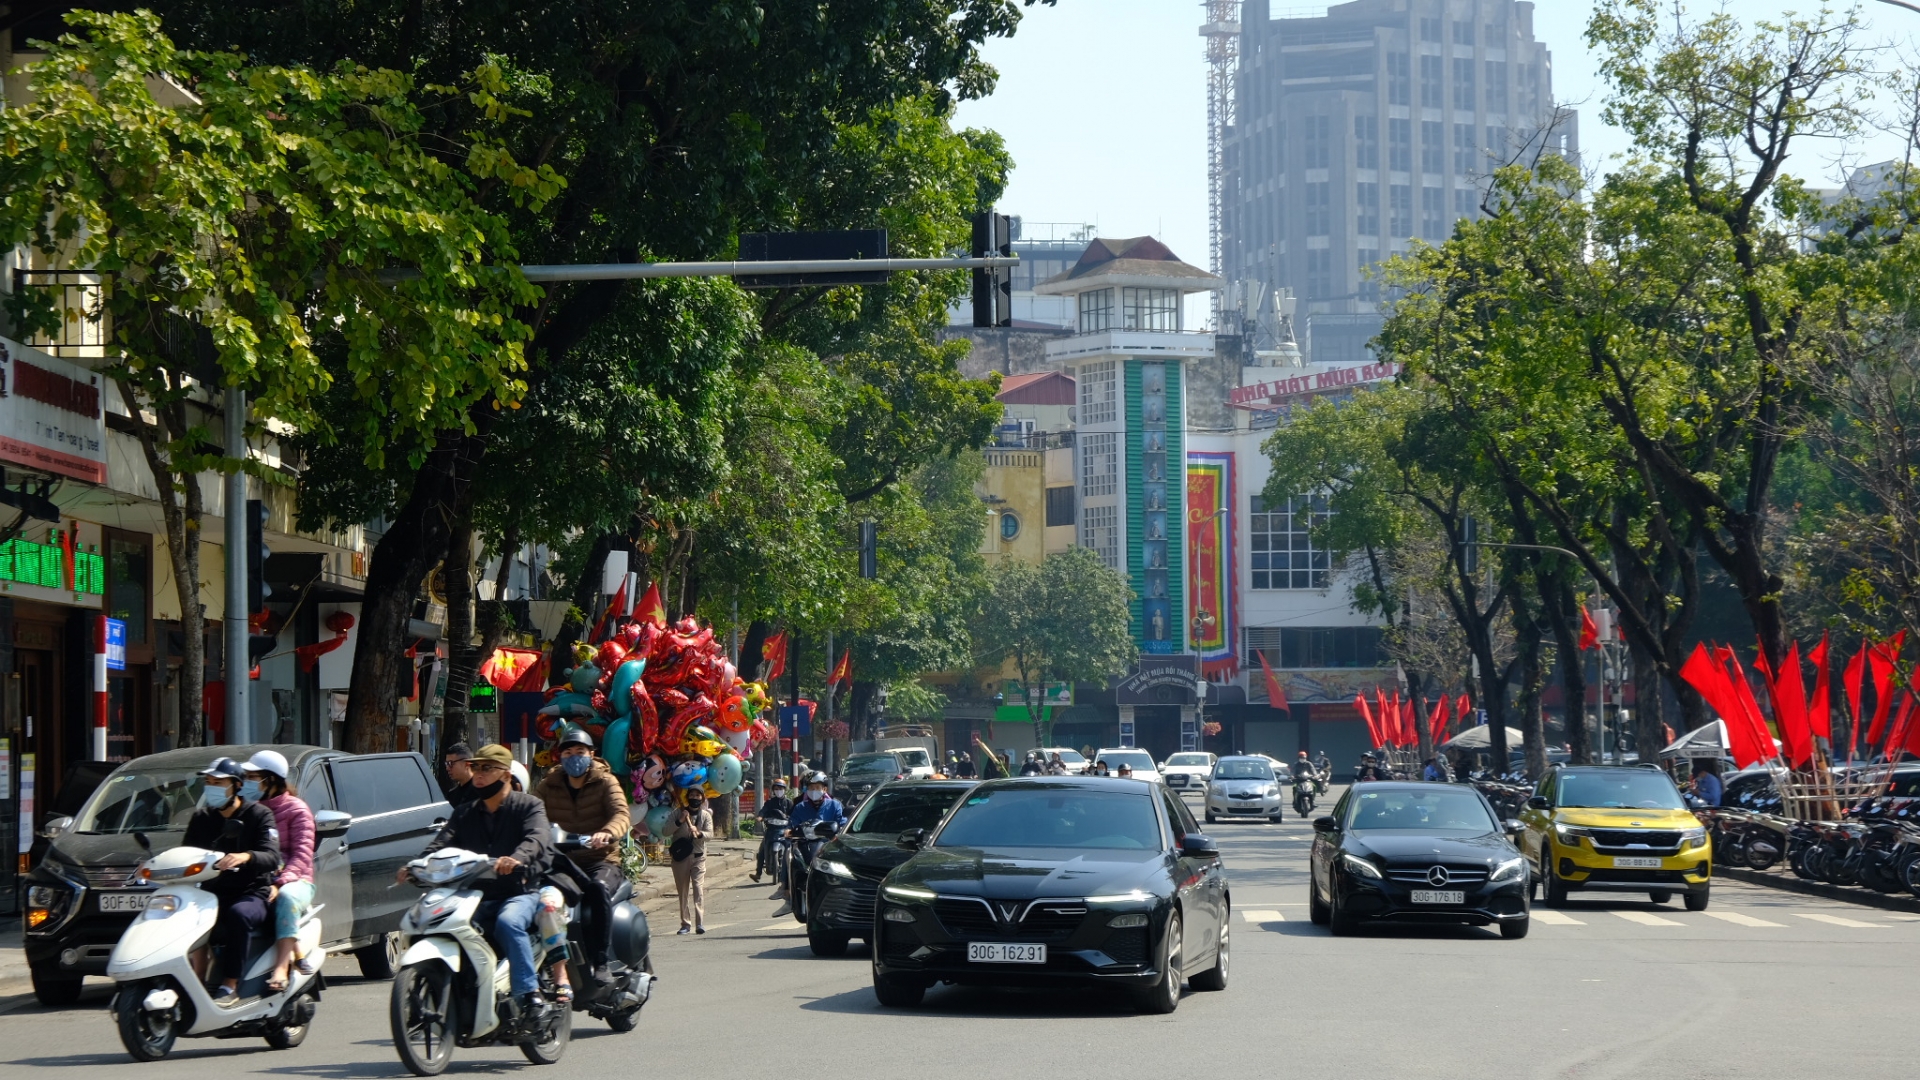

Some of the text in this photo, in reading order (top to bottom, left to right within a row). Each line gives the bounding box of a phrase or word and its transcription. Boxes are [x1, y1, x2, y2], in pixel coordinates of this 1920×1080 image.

[102, 895, 150, 910] 30F-64
[1413, 891, 1463, 903] 30G-176.18
[970, 944, 1043, 961] 30G-162.91
